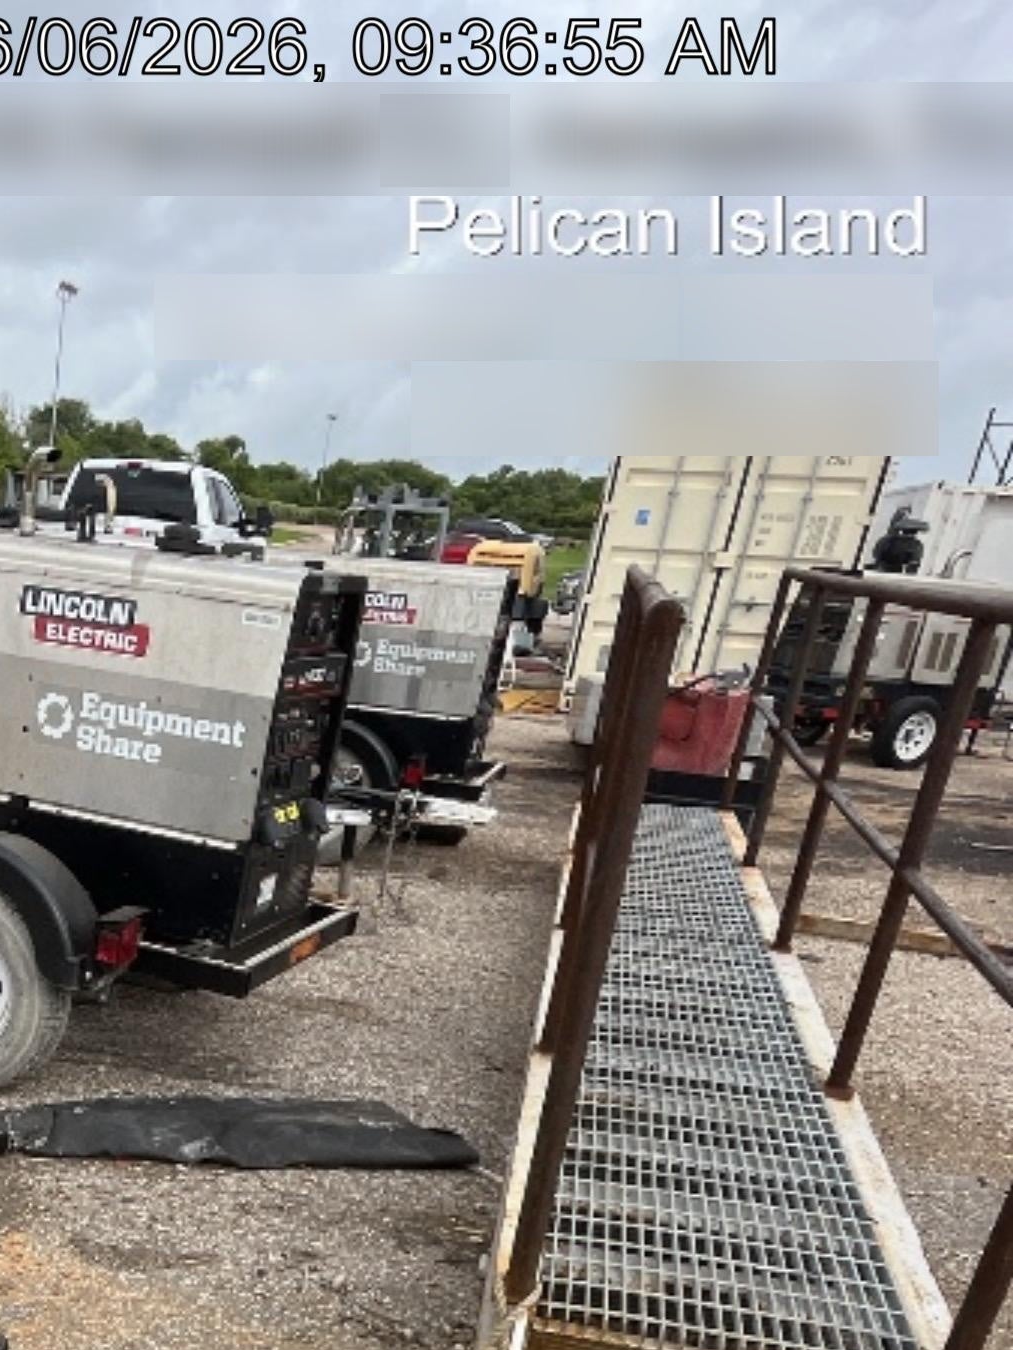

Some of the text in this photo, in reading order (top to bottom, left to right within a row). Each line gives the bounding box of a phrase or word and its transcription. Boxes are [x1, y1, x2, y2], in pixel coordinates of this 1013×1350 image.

[24, 588, 132, 626] LINCOLN
[45, 622, 139, 652] ELECTRIC
[79, 692, 247, 748] Equipment
[76, 725, 163, 764] Share
